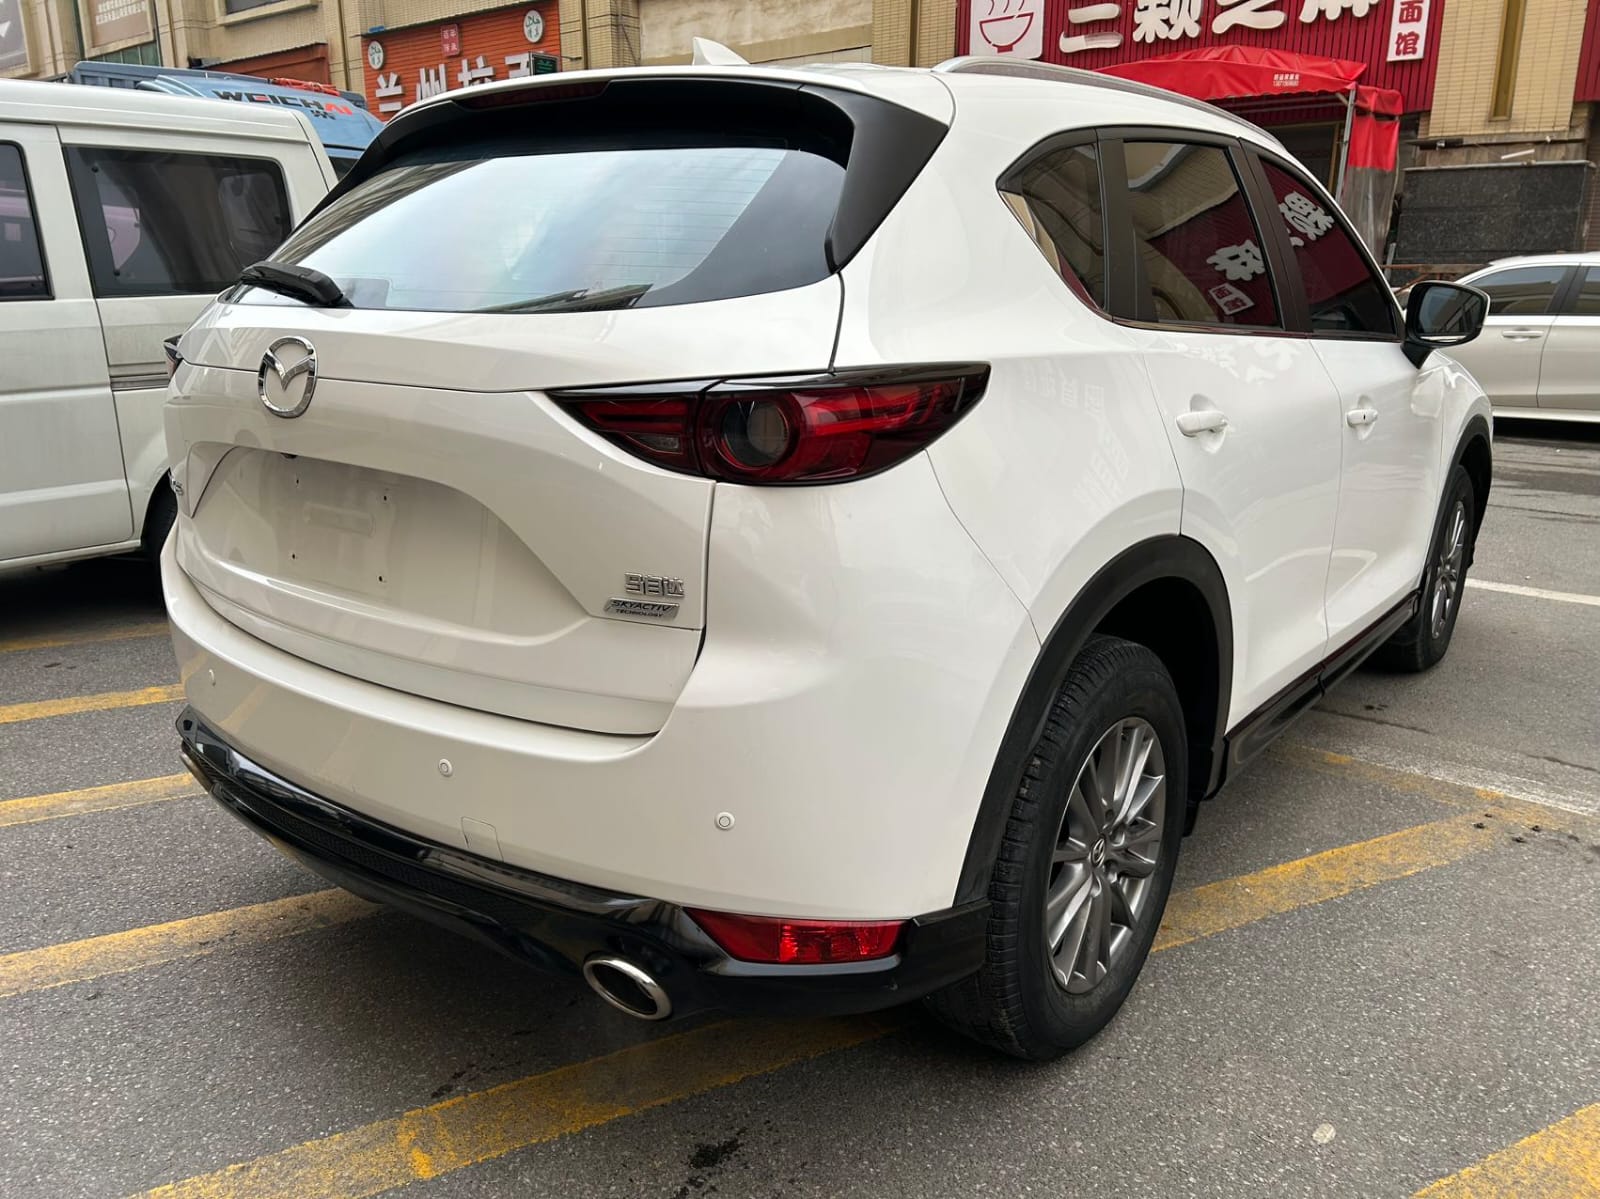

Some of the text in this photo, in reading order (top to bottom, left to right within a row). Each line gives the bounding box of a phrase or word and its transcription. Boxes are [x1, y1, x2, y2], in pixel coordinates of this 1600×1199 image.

[1058, 0, 1379, 53] 三颗
[1395, 1, 1424, 56] 面馆
[212, 90, 353, 115] WEICHAI
[625, 572, 685, 597] 马自达
[611, 600, 673, 612] SKYACTIV
[615, 609, 664, 617] TECHNOLOGY
